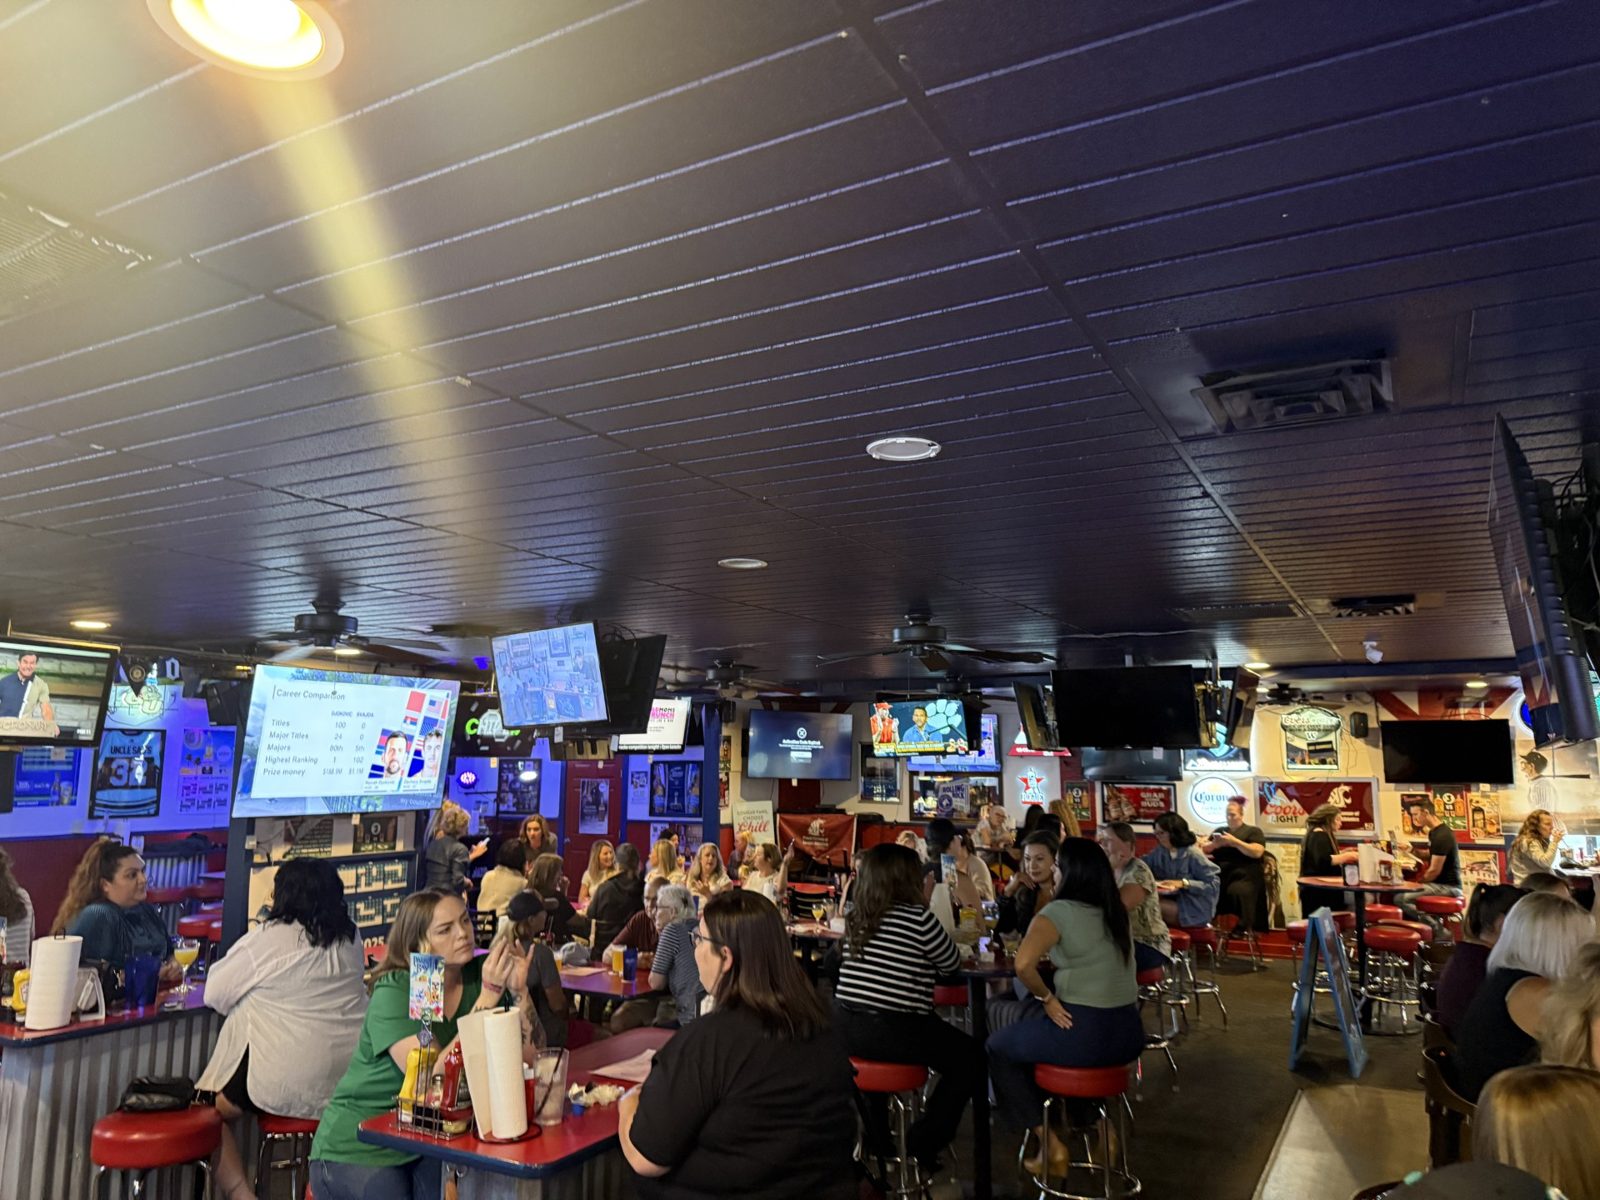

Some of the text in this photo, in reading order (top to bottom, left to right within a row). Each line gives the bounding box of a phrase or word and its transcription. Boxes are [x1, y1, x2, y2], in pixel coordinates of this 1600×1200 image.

[276, 688, 301, 698] Career
[269, 731, 290, 740] Major
[291, 732, 309, 740] Titles
[110, 746, 130, 754] UNCLE
[267, 744, 291, 752] Majors
[264, 756, 291, 765] Highest
[292, 756, 318, 765] Ranking
[110, 758, 148, 786] 32
[282, 768, 306, 776] money
[942, 784, 964, 792] ROLLING
[1194, 791, 1229, 803] Coron
[1270, 816, 1298, 824] LIGHT
